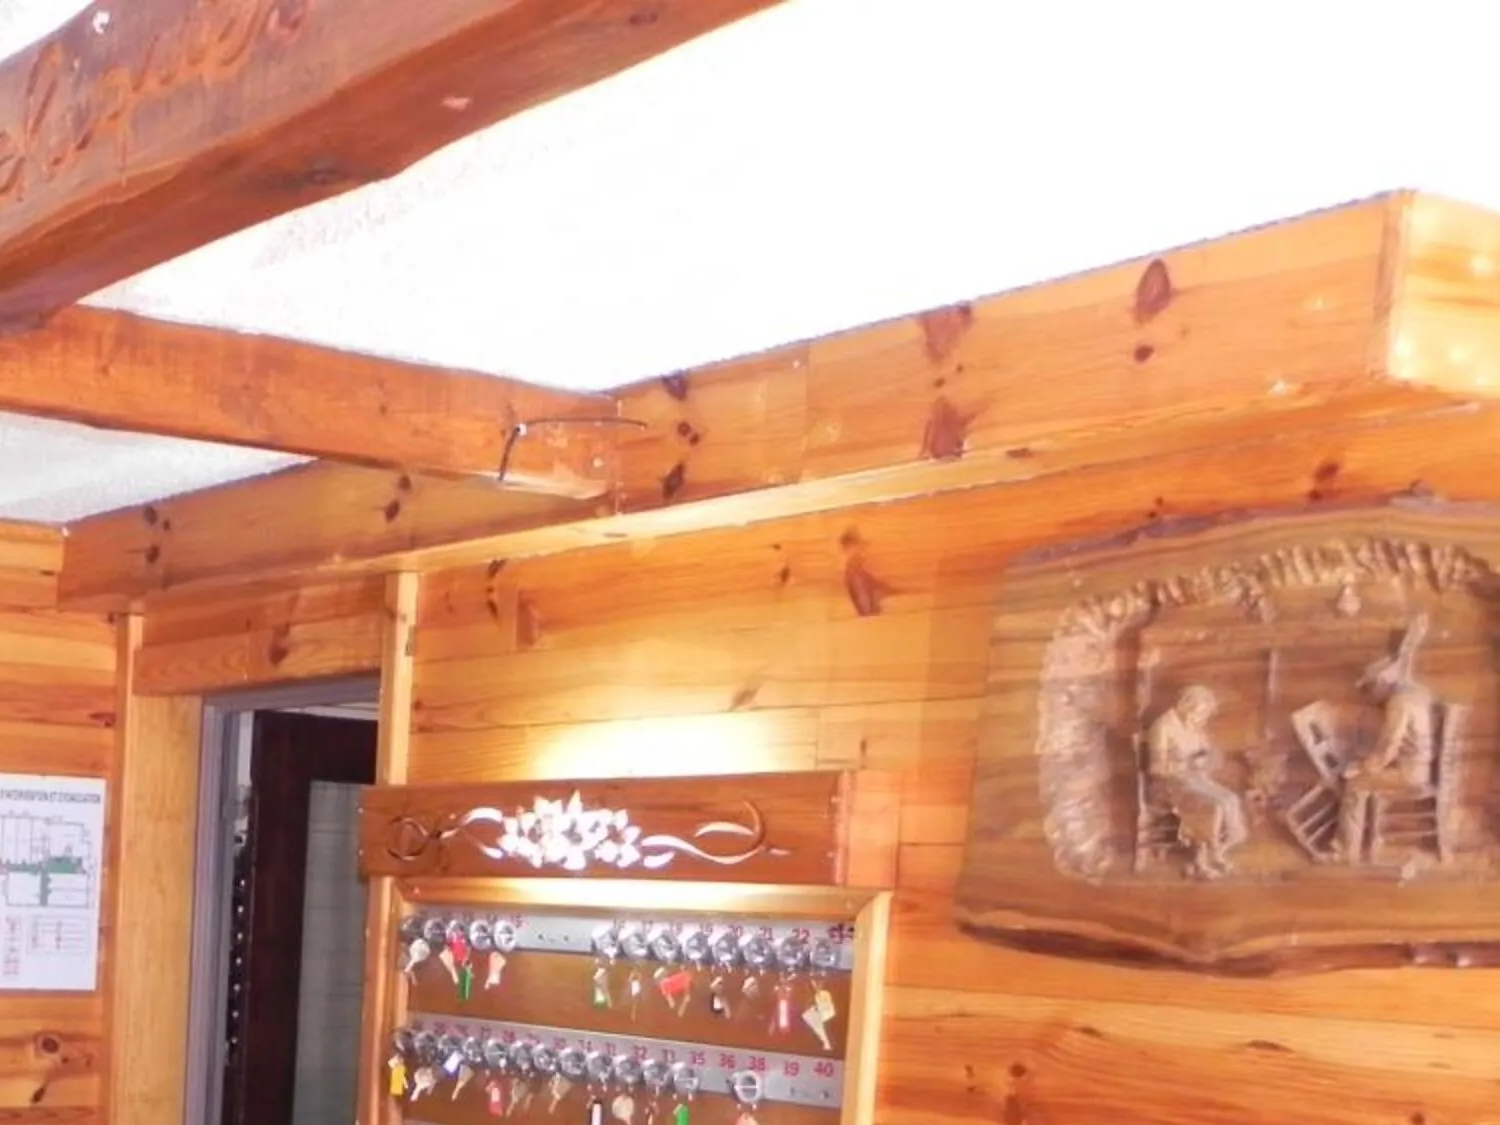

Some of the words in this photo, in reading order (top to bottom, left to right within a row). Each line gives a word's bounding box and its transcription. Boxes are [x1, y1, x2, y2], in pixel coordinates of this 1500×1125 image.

[718, 1052, 736, 1070] 36
[747, 1054, 766, 1072] 38
[813, 1061, 836, 1079] 40
